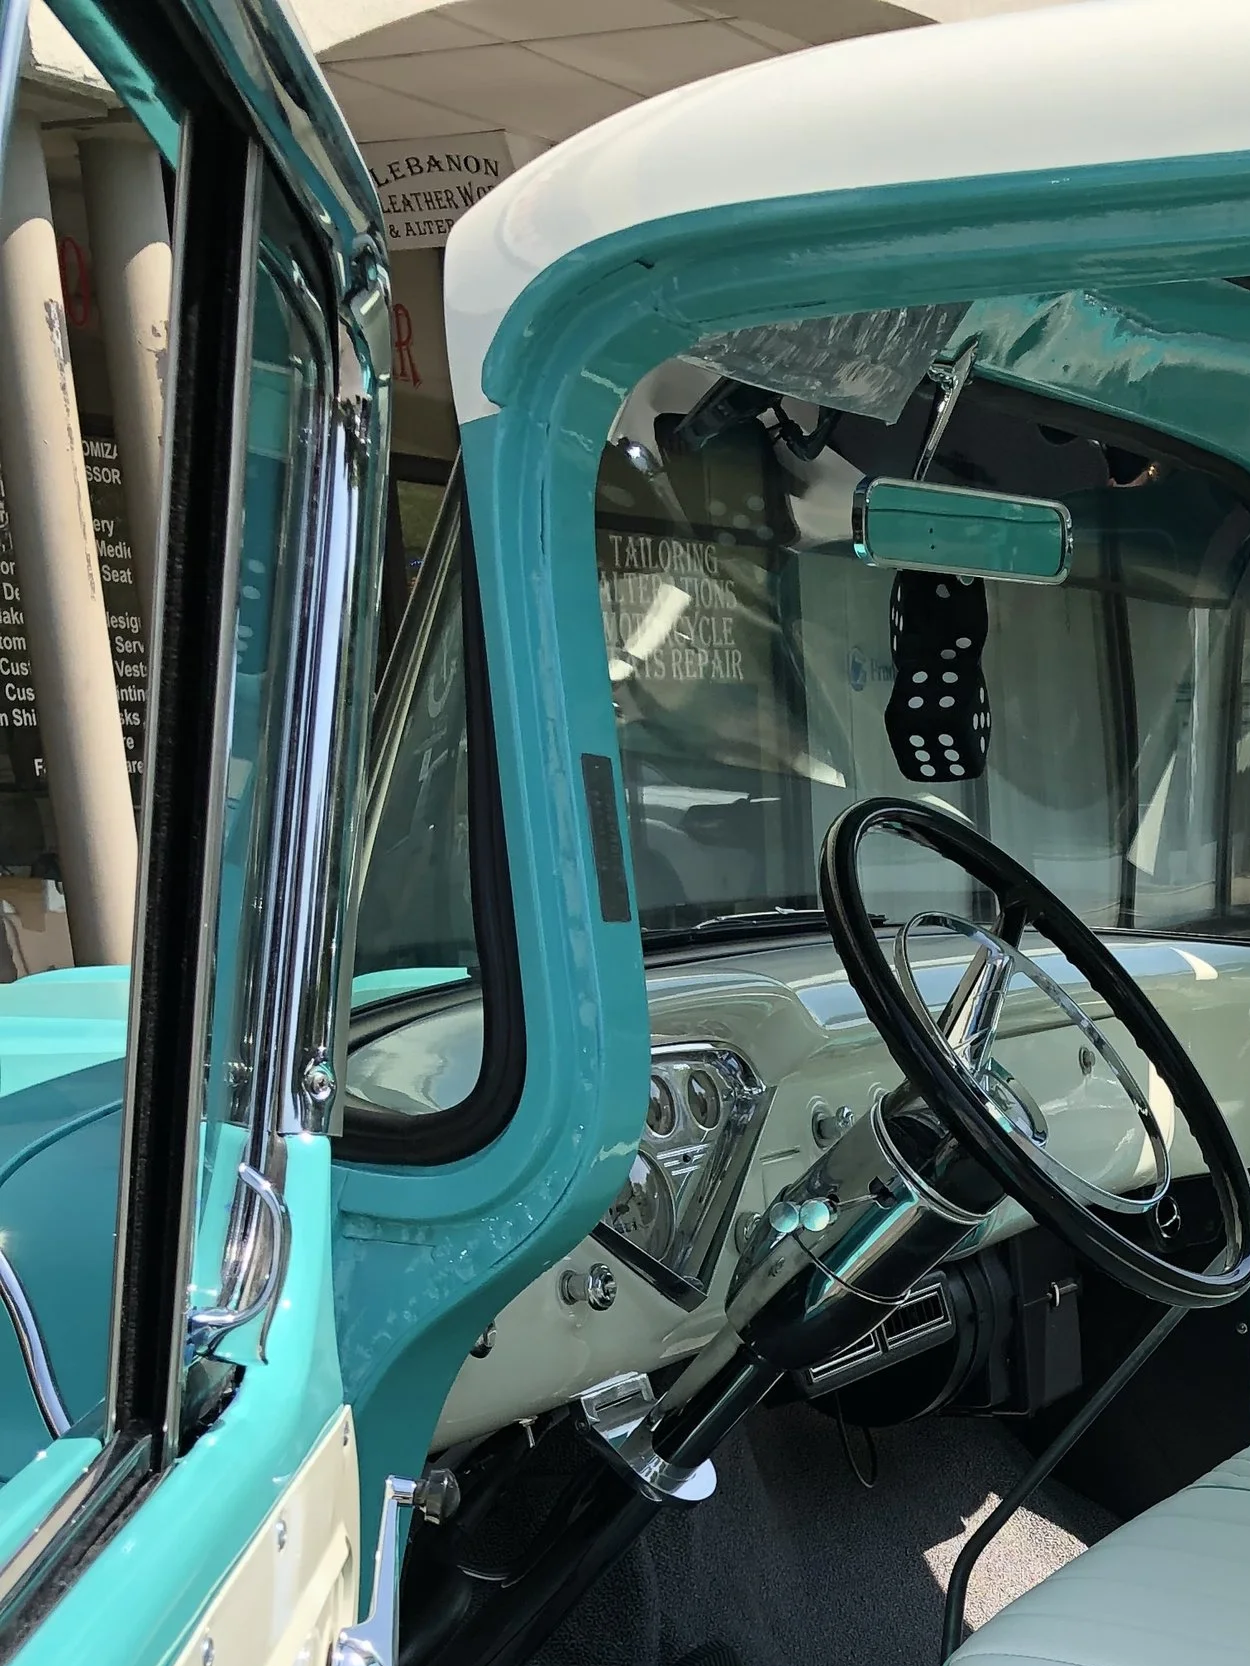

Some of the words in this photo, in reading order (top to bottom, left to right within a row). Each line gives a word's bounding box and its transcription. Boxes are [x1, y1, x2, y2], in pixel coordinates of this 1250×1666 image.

[369, 153, 499, 188] LEBANON
[379, 188, 458, 214] LEATHER
[388, 223, 401, 239] &
[609, 535, 719, 576] TAILORING
[600, 571, 738, 609] ALTERTIONS
[671, 648, 744, 681] REPAIR
